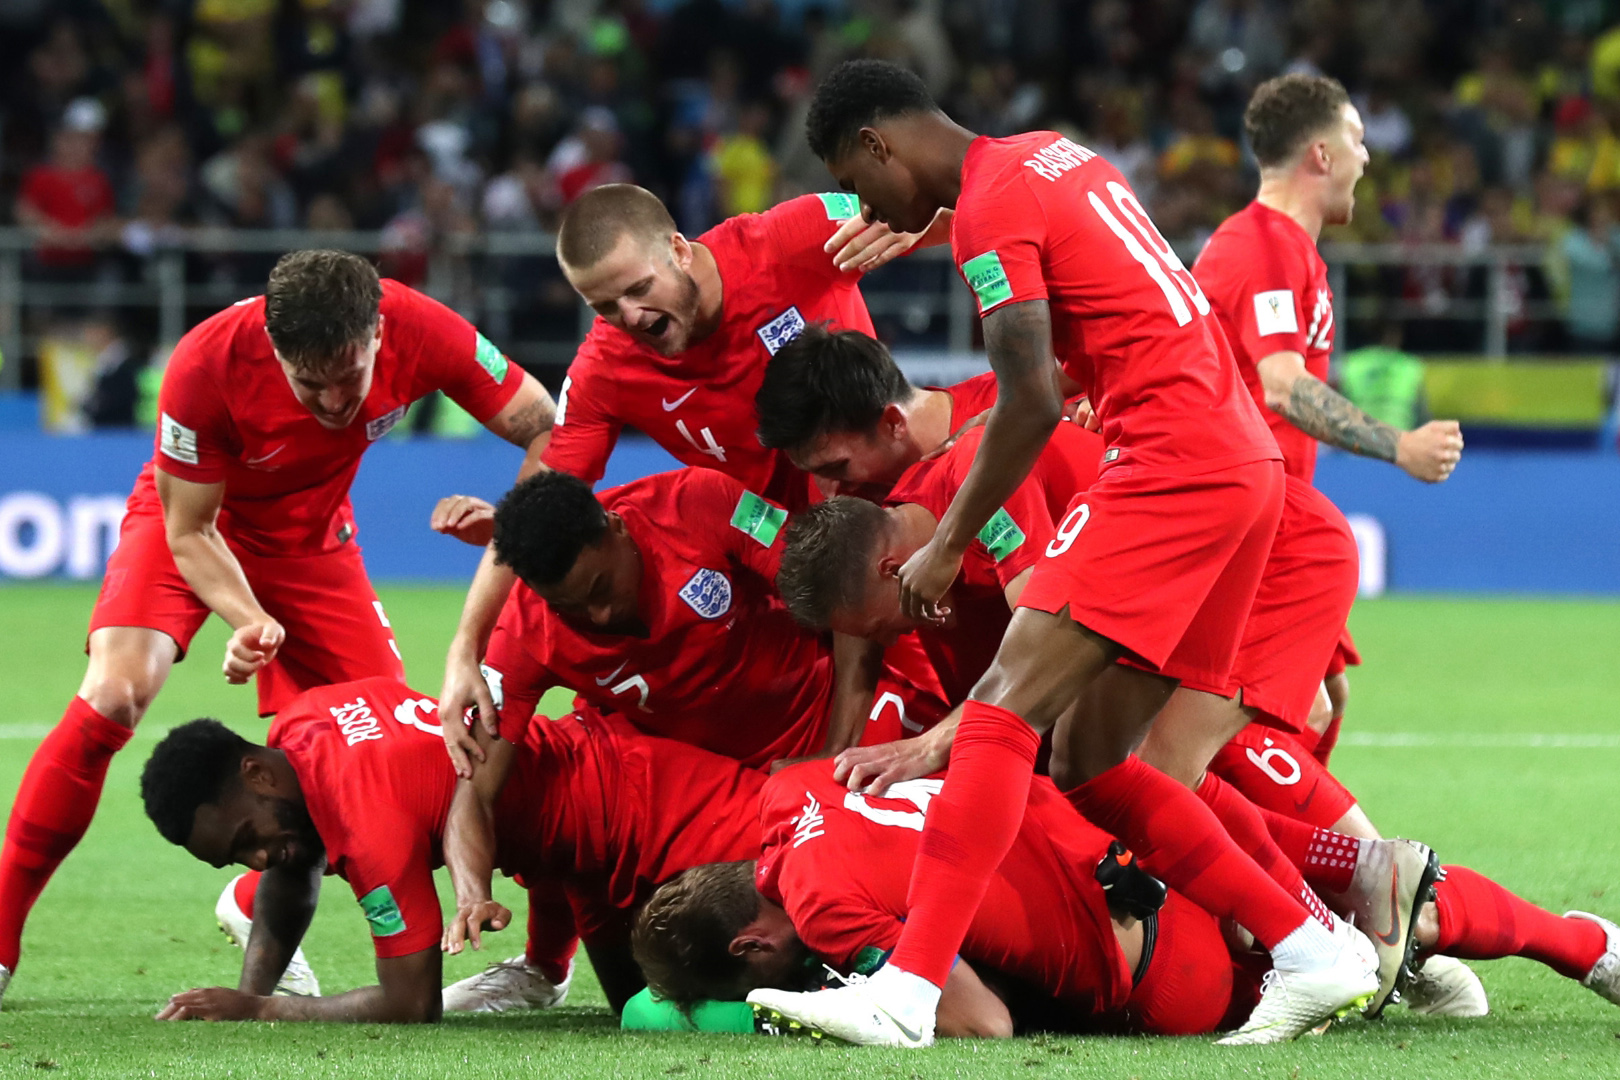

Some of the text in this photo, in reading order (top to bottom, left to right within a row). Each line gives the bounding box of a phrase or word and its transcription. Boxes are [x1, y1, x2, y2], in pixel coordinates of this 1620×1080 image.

[1023, 137, 1098, 182] RASHFOR
[1087, 181, 1211, 328] 19
[675, 419, 728, 463] 4
[1045, 503, 1090, 558] 9
[610, 673, 655, 714] 7
[869, 691, 924, 733] 7
[329, 697, 384, 747] ROSE
[1246, 737, 1302, 786] 6
